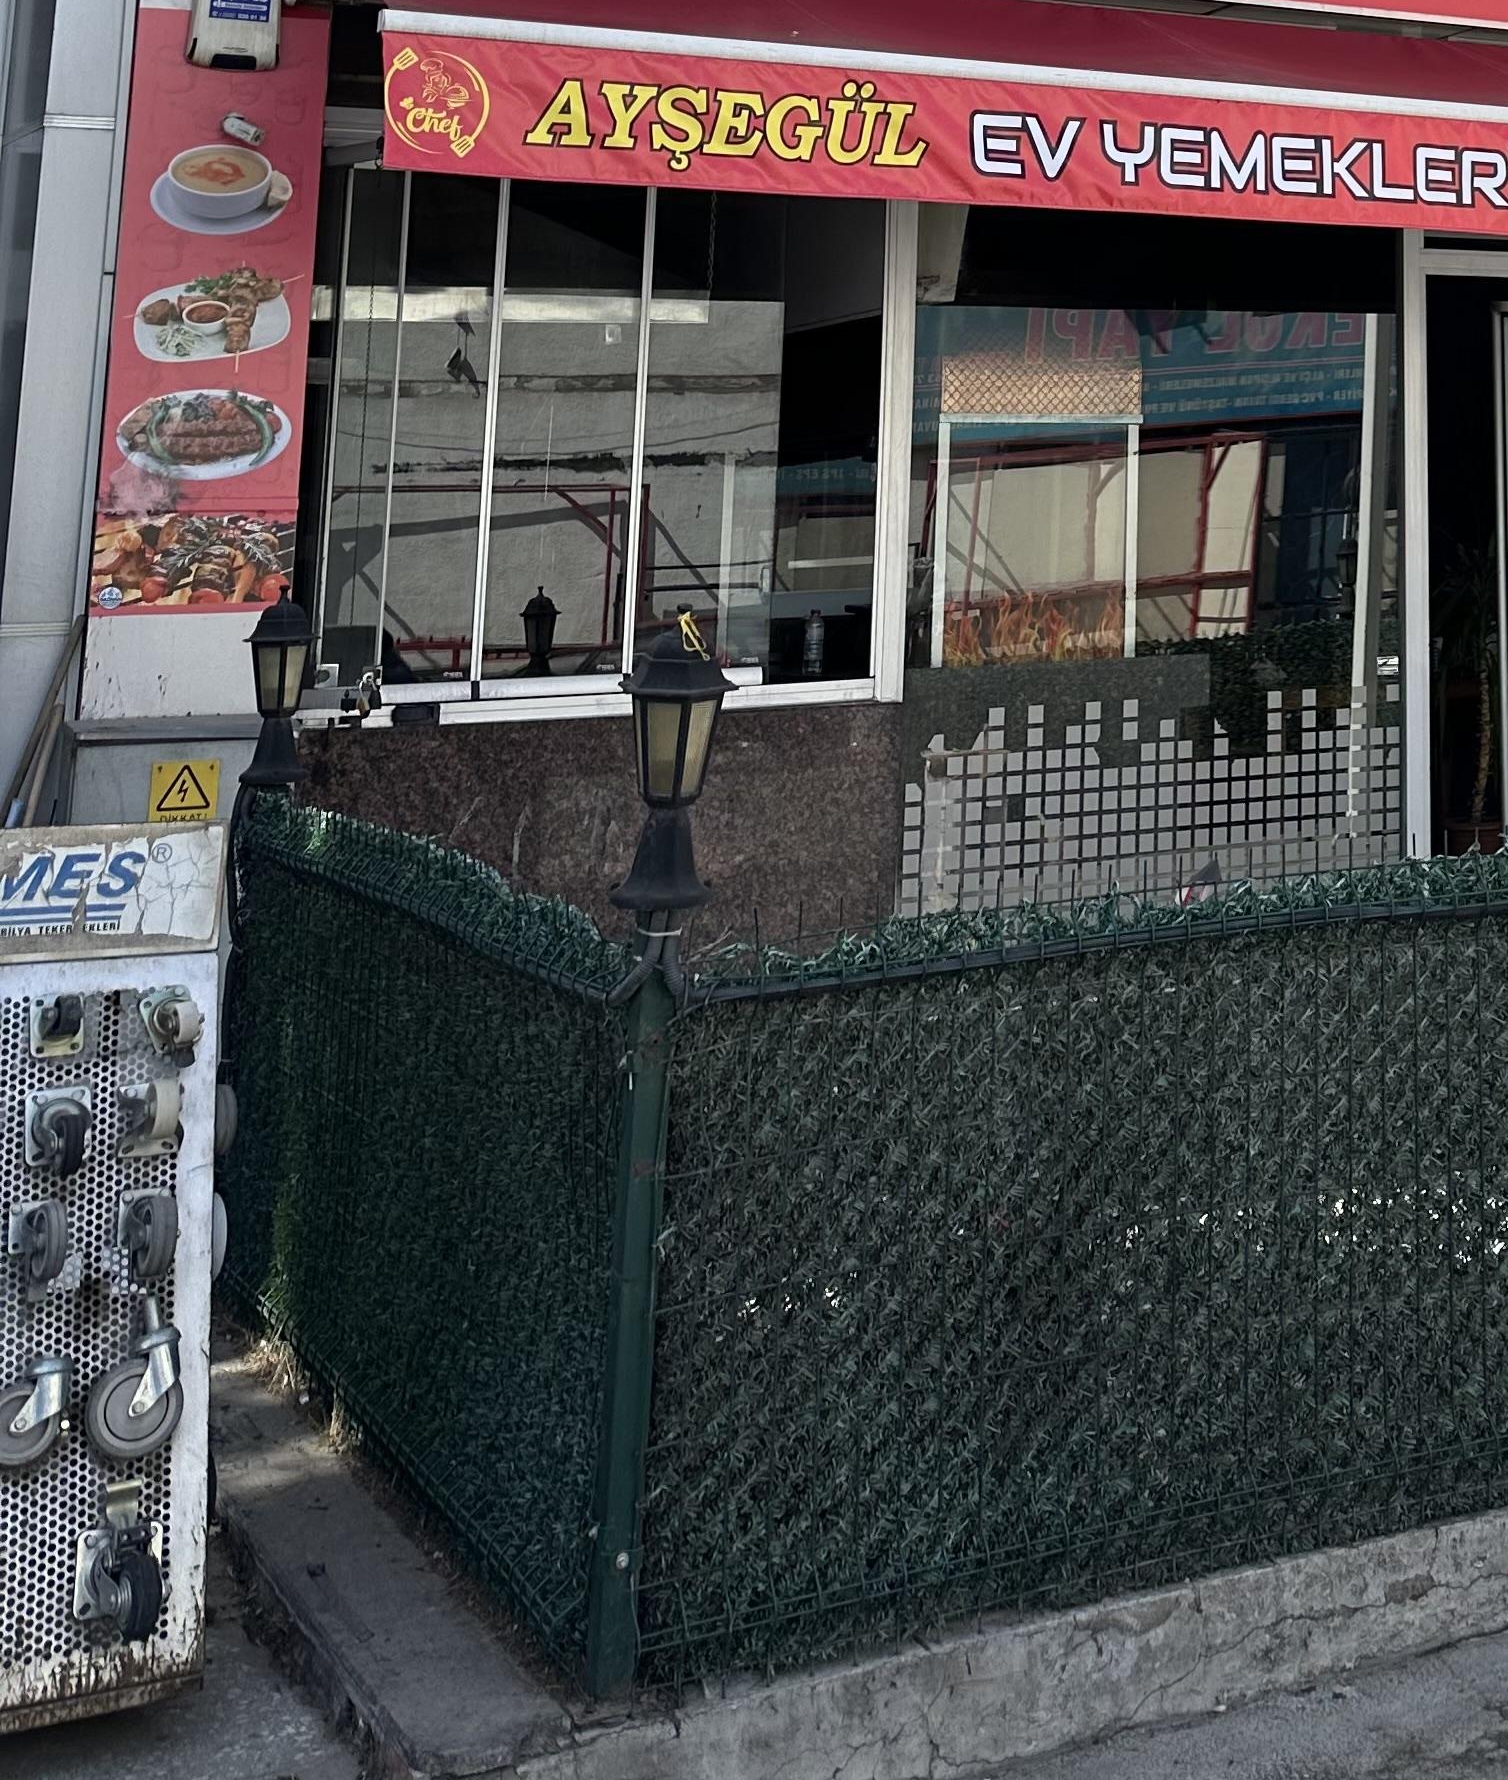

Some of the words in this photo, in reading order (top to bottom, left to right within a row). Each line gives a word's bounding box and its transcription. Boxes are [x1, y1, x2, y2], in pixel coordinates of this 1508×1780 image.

[407, 104, 467, 141] Chef
[523, 78, 928, 171] AYŞEGÜL
[970, 108, 1084, 182] EV
